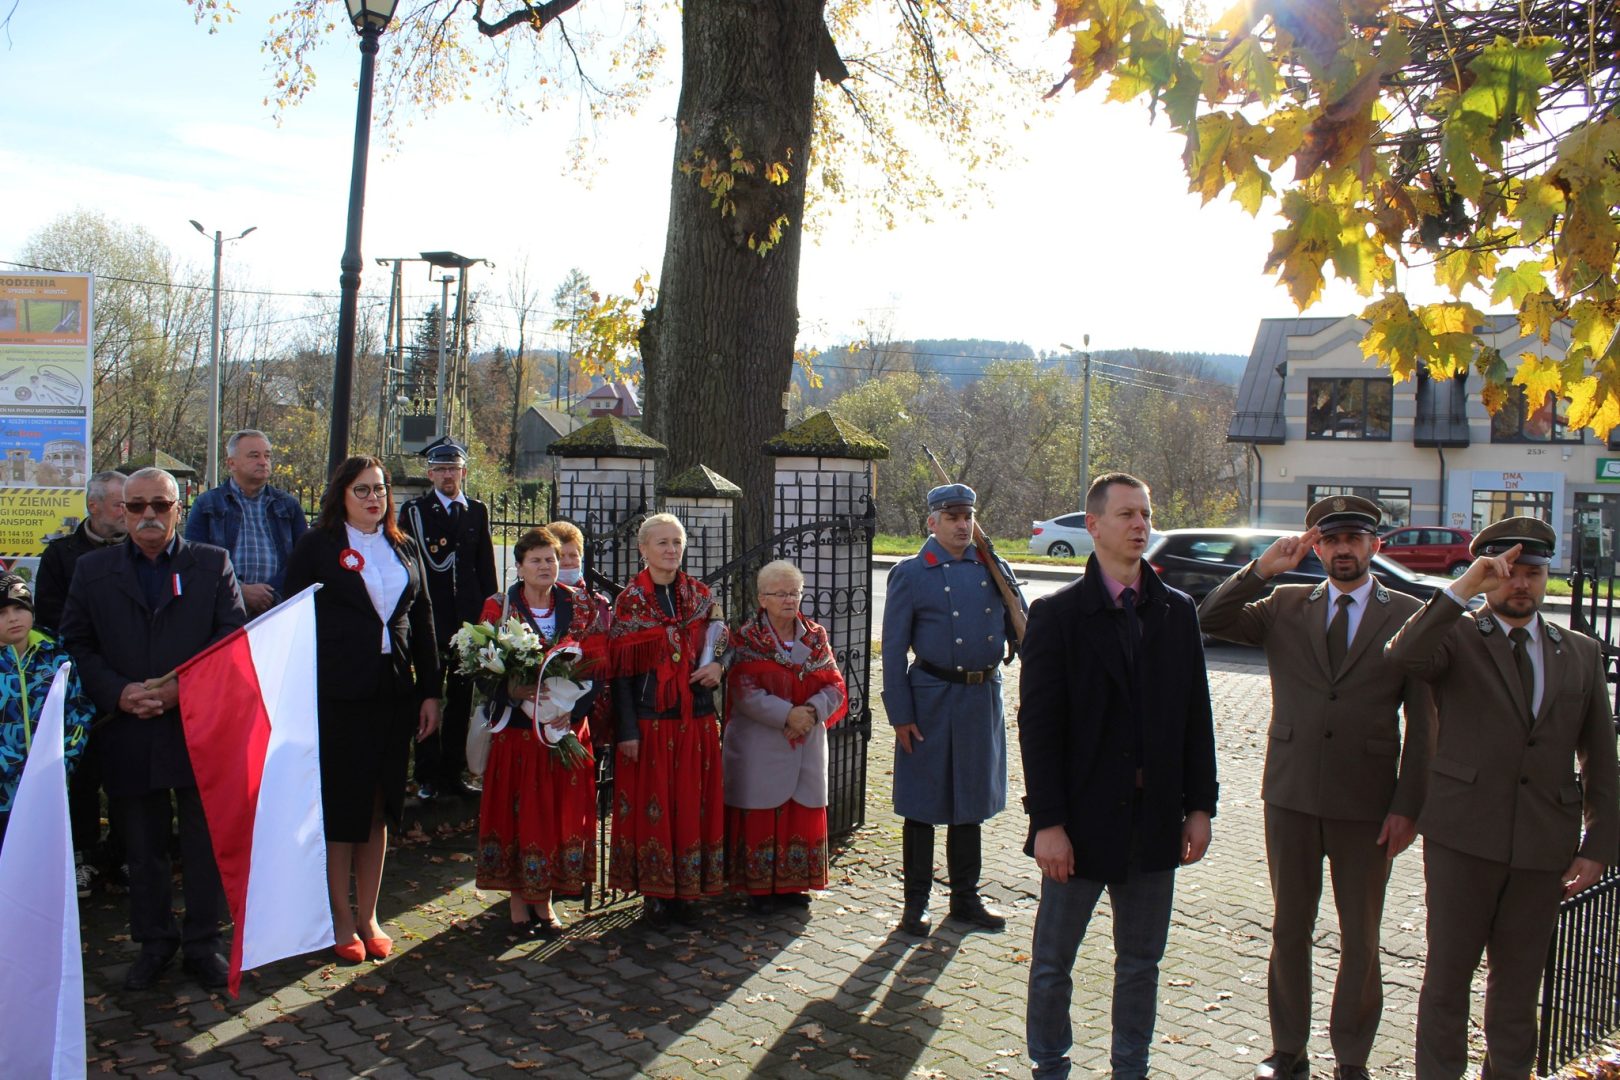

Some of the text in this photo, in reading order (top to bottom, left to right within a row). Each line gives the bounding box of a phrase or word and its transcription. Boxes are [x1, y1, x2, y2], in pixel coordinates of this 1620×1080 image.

[0, 496, 70, 507] TY ZIEMNE
[12, 509, 55, 519] KOPARKĄ
